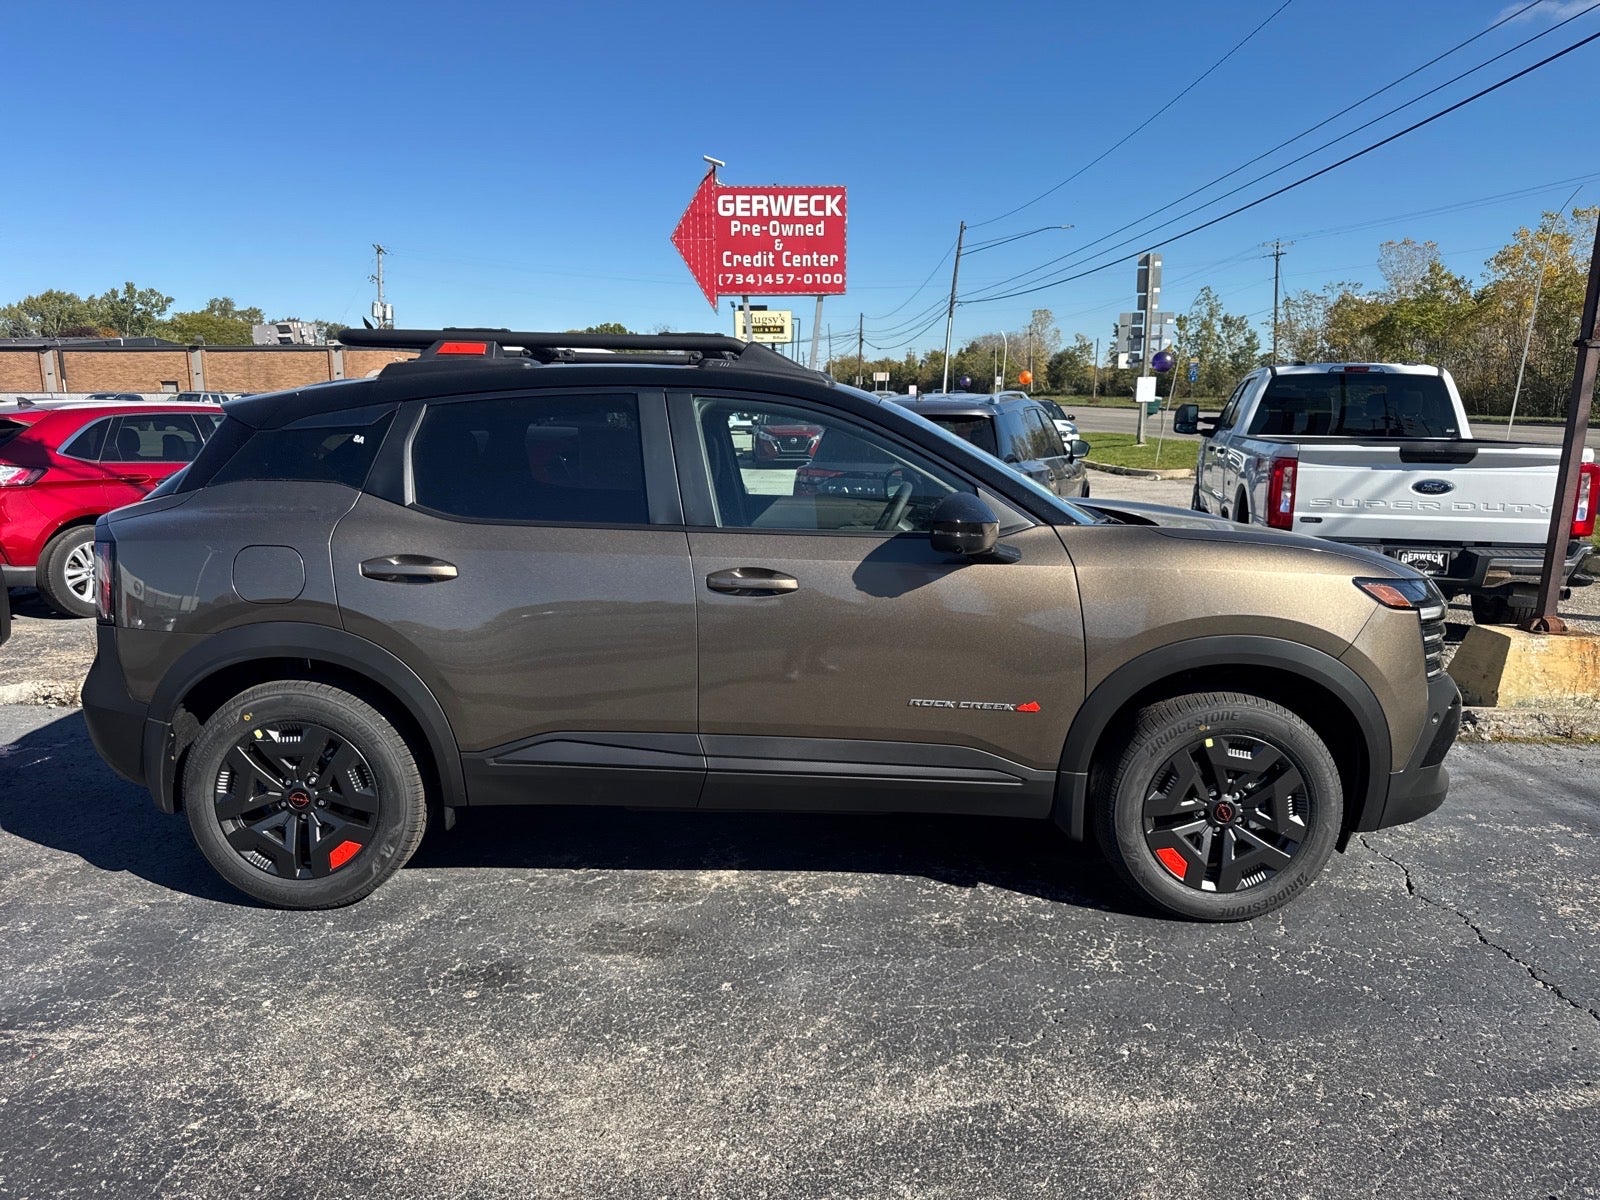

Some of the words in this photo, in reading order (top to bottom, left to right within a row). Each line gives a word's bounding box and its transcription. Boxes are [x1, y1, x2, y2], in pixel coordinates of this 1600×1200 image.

[717, 194, 843, 217] GERWECK
[730, 220, 825, 237] Pre-Owned
[774, 238, 784, 251] &
[722, 251, 775, 267] Credit
[782, 251, 839, 267] Center
[718, 273, 843, 286] (734)457-0100
[742, 313, 786, 327] Mugsy's
[1309, 498, 1441, 511] SUPER
[1451, 501, 1553, 514] DUTY
[1400, 552, 1444, 567] GERWECK
[908, 698, 957, 708] ROCK
[958, 701, 1017, 711] CREEK
[1144, 710, 1241, 758] BRIDGESTONE
